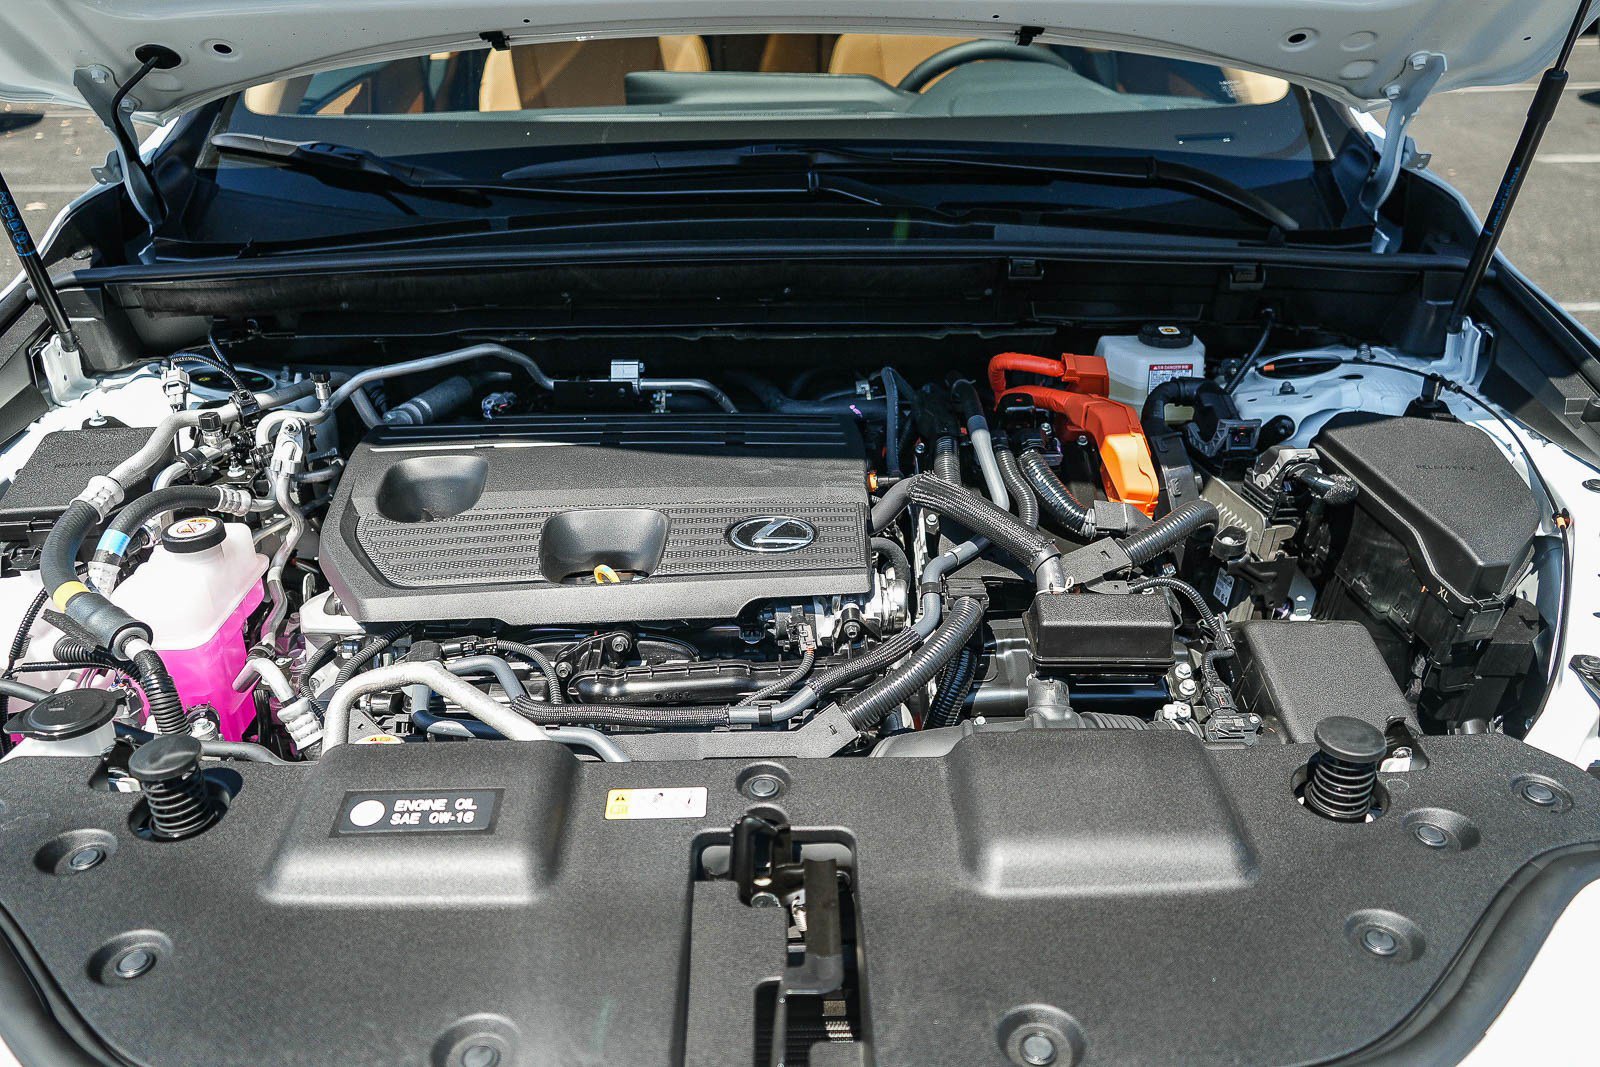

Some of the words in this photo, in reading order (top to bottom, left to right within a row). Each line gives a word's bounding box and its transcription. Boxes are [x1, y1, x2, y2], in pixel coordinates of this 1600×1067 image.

[394, 799, 447, 811] ENGINE
[454, 798, 477, 810] OIL
[390, 812, 421, 825] SAE
